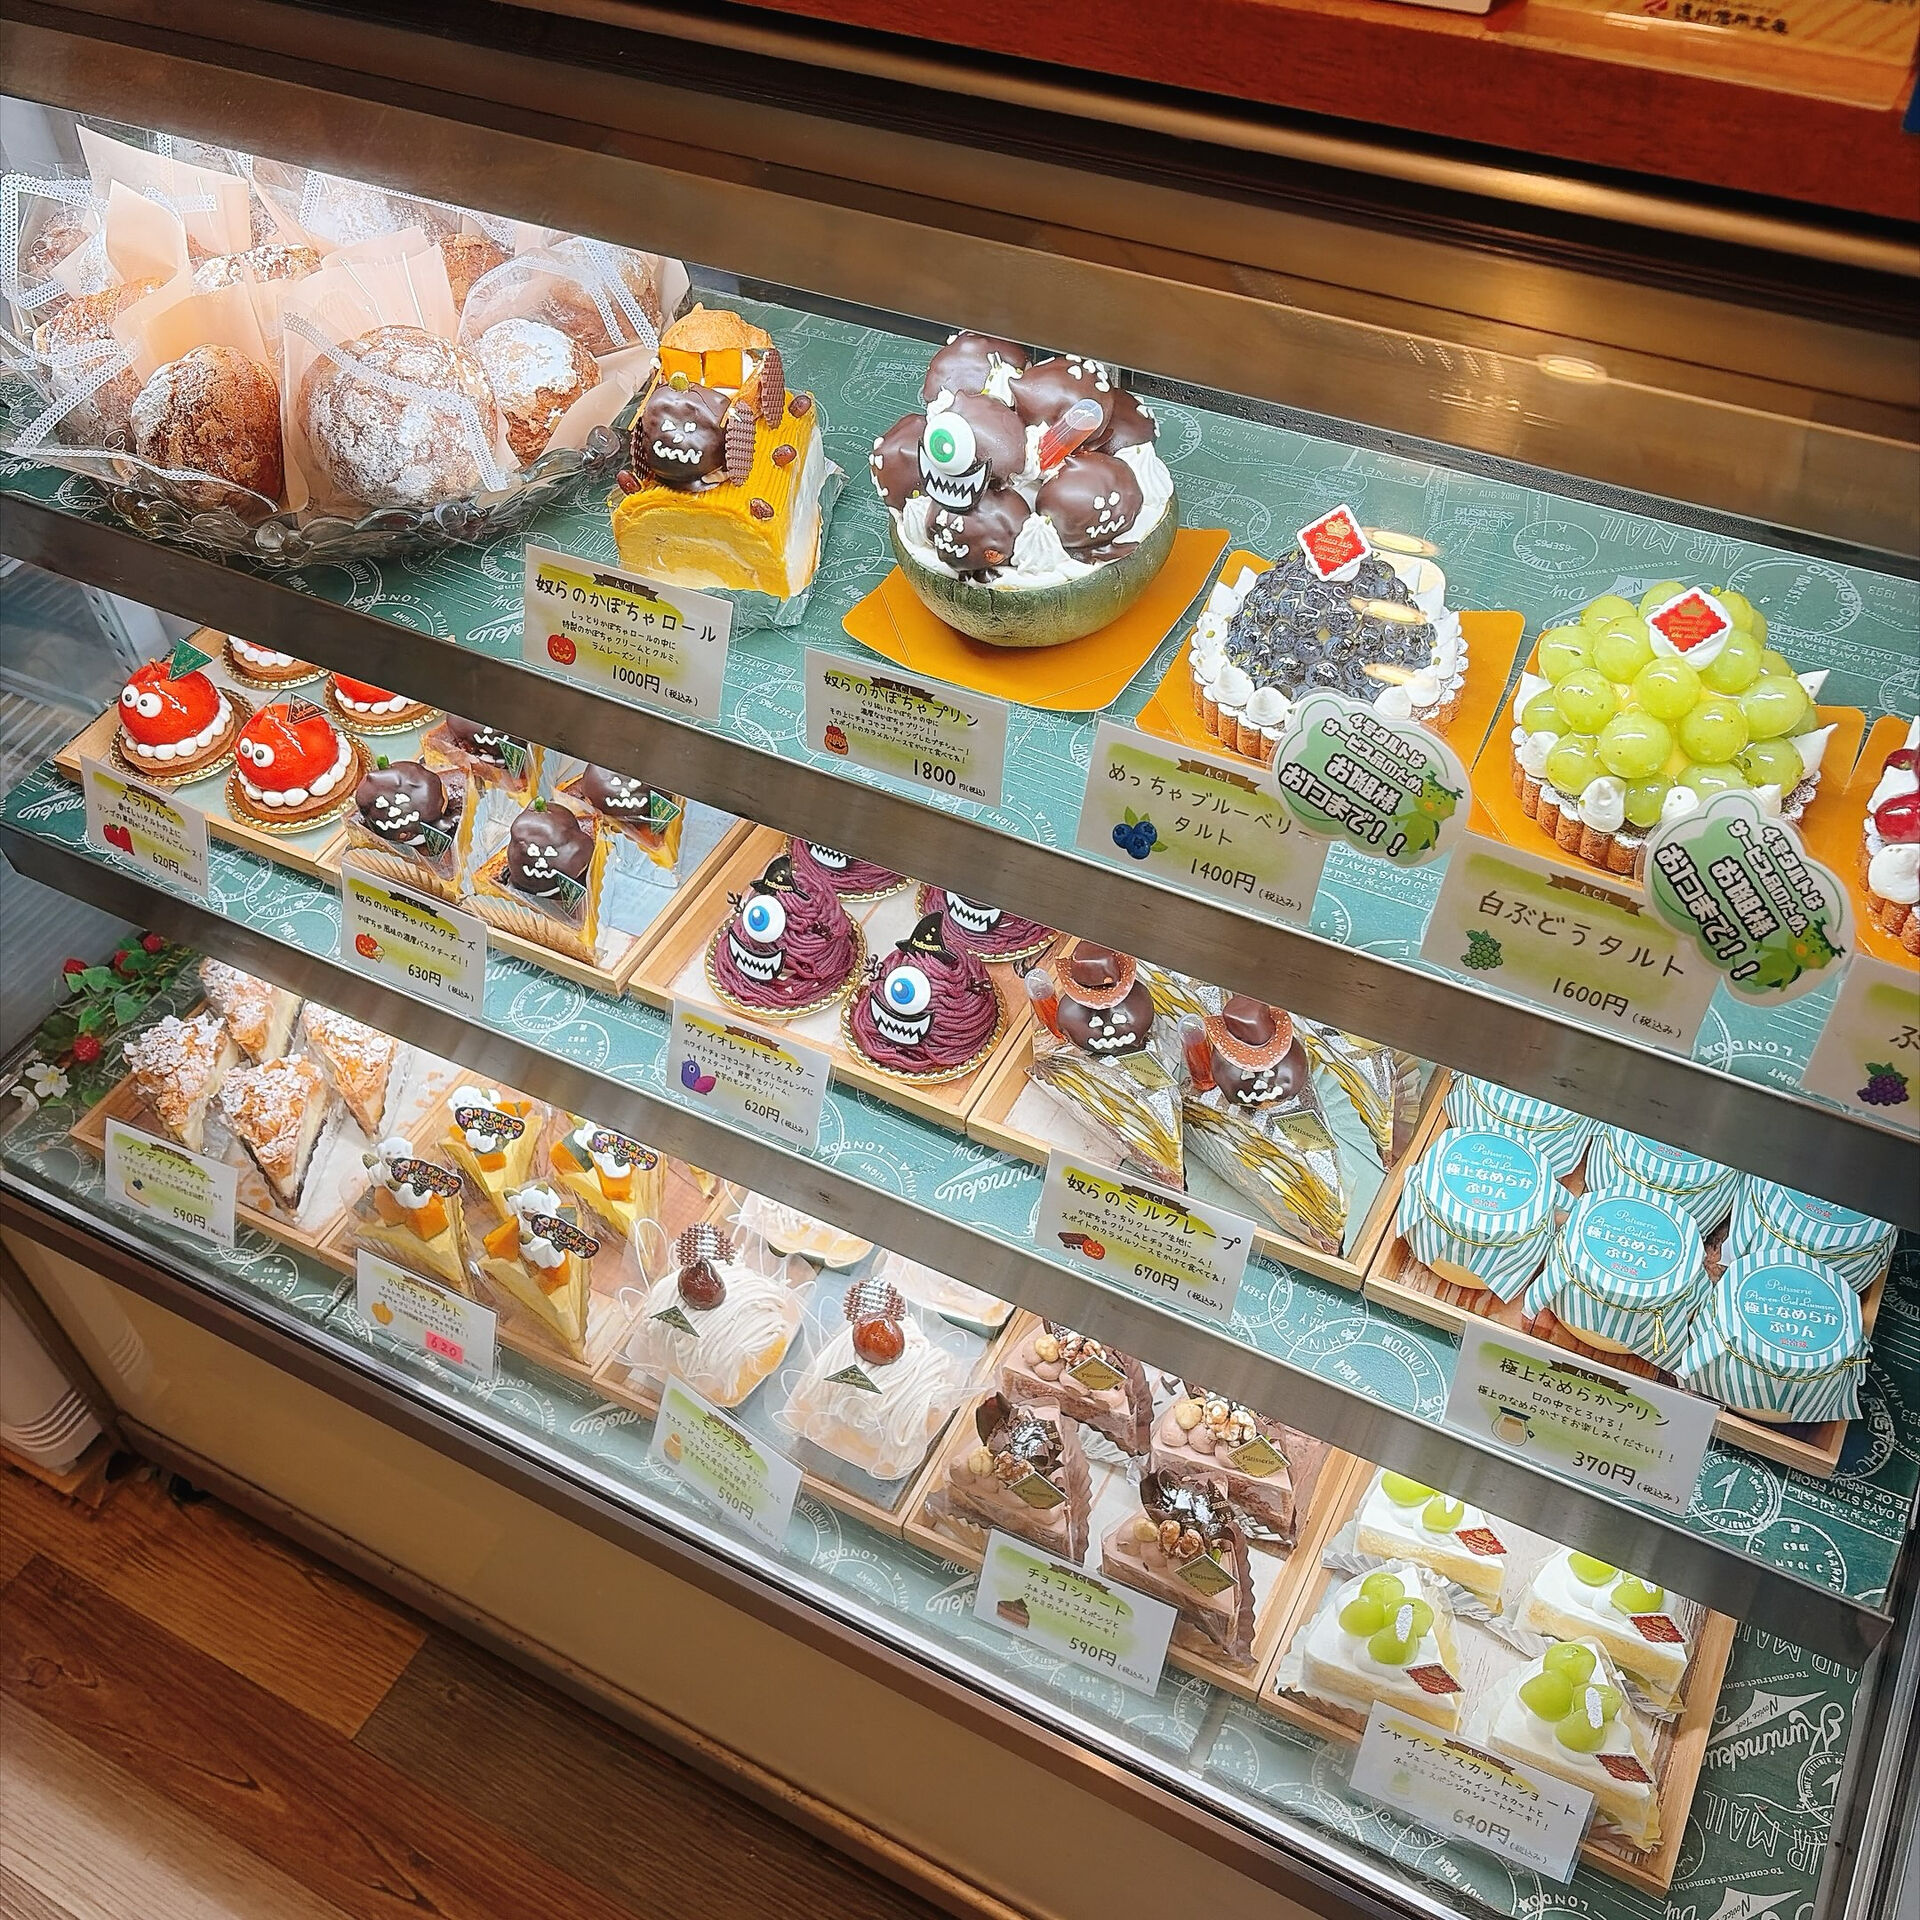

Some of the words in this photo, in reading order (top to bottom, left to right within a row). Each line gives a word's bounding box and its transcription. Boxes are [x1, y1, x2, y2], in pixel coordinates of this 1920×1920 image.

[1600, 514, 1678, 554] MAIL
[1549, 569, 1608, 580] something
[1610, 562, 1666, 573] construct
[535, 574, 716, 643] 奴らのかぼちゃロール
[1550, 584, 1588, 600] Diy
[392, 612, 419, 628] FLIGHT
[571, 610, 675, 650] しっとりかぼちゃロールの中に
[1797, 641, 1826, 655] STAY
[1828, 648, 1859, 662] DAYS
[1861, 649, 1892, 659] DATE
[612, 665, 660, 694] 1000円
[824, 672, 978, 727] 奴らのかぼちゃプリン
[1322, 718, 1423, 797] サービス品のため、
[1350, 713, 1426, 770] 4号タルトは
[914, 759, 956, 786] 1800
[1204, 767, 1232, 783] A.C.L
[121, 789, 177, 824] スラりんご
[1108, 762, 1312, 838] めっちゃブルーベリー
[1175, 816, 1232, 846] タルト
[152, 853, 179, 875] 620円
[1345, 861, 1376, 876] STAY
[1380, 871, 1411, 887] DAYS
[1727, 818, 1809, 937] サービス品のため、
[1762, 826, 1825, 912] 4号タルトは
[1191, 859, 1256, 893] 1400円
[1258, 891, 1302, 911] (税込み)
[355, 891, 476, 951] 奴らのかぼちゃバスクチーズ
[1479, 890, 1685, 977] 白ぶどうタルト
[408, 964, 442, 987] 630円
[1553, 977, 1629, 1018] 1600円
[1632, 1013, 1681, 1038] (税込み)
[685, 1022, 816, 1079] ヴァイオレットモンスター
[744, 1099, 780, 1123] 620円
[127, 1144, 216, 1184] インディアンサマー
[861, 1162, 887, 1182] FLIGHT
[1446, 1162, 1534, 1190] 極上なめらか
[1465, 1183, 1508, 1200] ぷりん
[173, 1207, 206, 1229] 590円
[1067, 1173, 1241, 1251] 奴らのミルクレープ
[1104, 1208, 1192, 1249] もっちりクレープ生地に
[1586, 1225, 1676, 1260] 極上なめらか
[1605, 1247, 1648, 1269] ぷりん
[388, 1278, 461, 1318] かぼちゃタルト
[1133, 1263, 1179, 1292] 670円
[1187, 1290, 1224, 1311] (税込み)
[1744, 1300, 1839, 1326] 極上なめらか
[1769, 1321, 1816, 1339] ぷりん
[431, 1338, 458, 1357] 620
[1380, 1336, 1430, 1379] LONDON
[1500, 1357, 1669, 1427] 極上なめらかプリン
[1532, 1391, 1624, 1432] 口の中でとろける!
[702, 1415, 753, 1459] モンブラン
[1572, 1450, 1637, 1487] 370円
[1636, 1482, 1681, 1505] (税込み)
[1790, 1471, 1826, 1493] FROM
[717, 1487, 754, 1521] 590円
[1828, 1488, 1859, 1507] STAY
[1863, 1500, 1894, 1521] DAYS
[1028, 1567, 1127, 1617] チョコショート
[1069, 1637, 1117, 1668] 590円
[1749, 1672, 1794, 1685] construct
[1378, 1721, 1577, 1816] シャインマスカットショート
[1452, 1809, 1511, 1844] 640円
[1703, 1790, 1780, 1858] MAIL
[1718, 1870, 1768, 1883] construct
